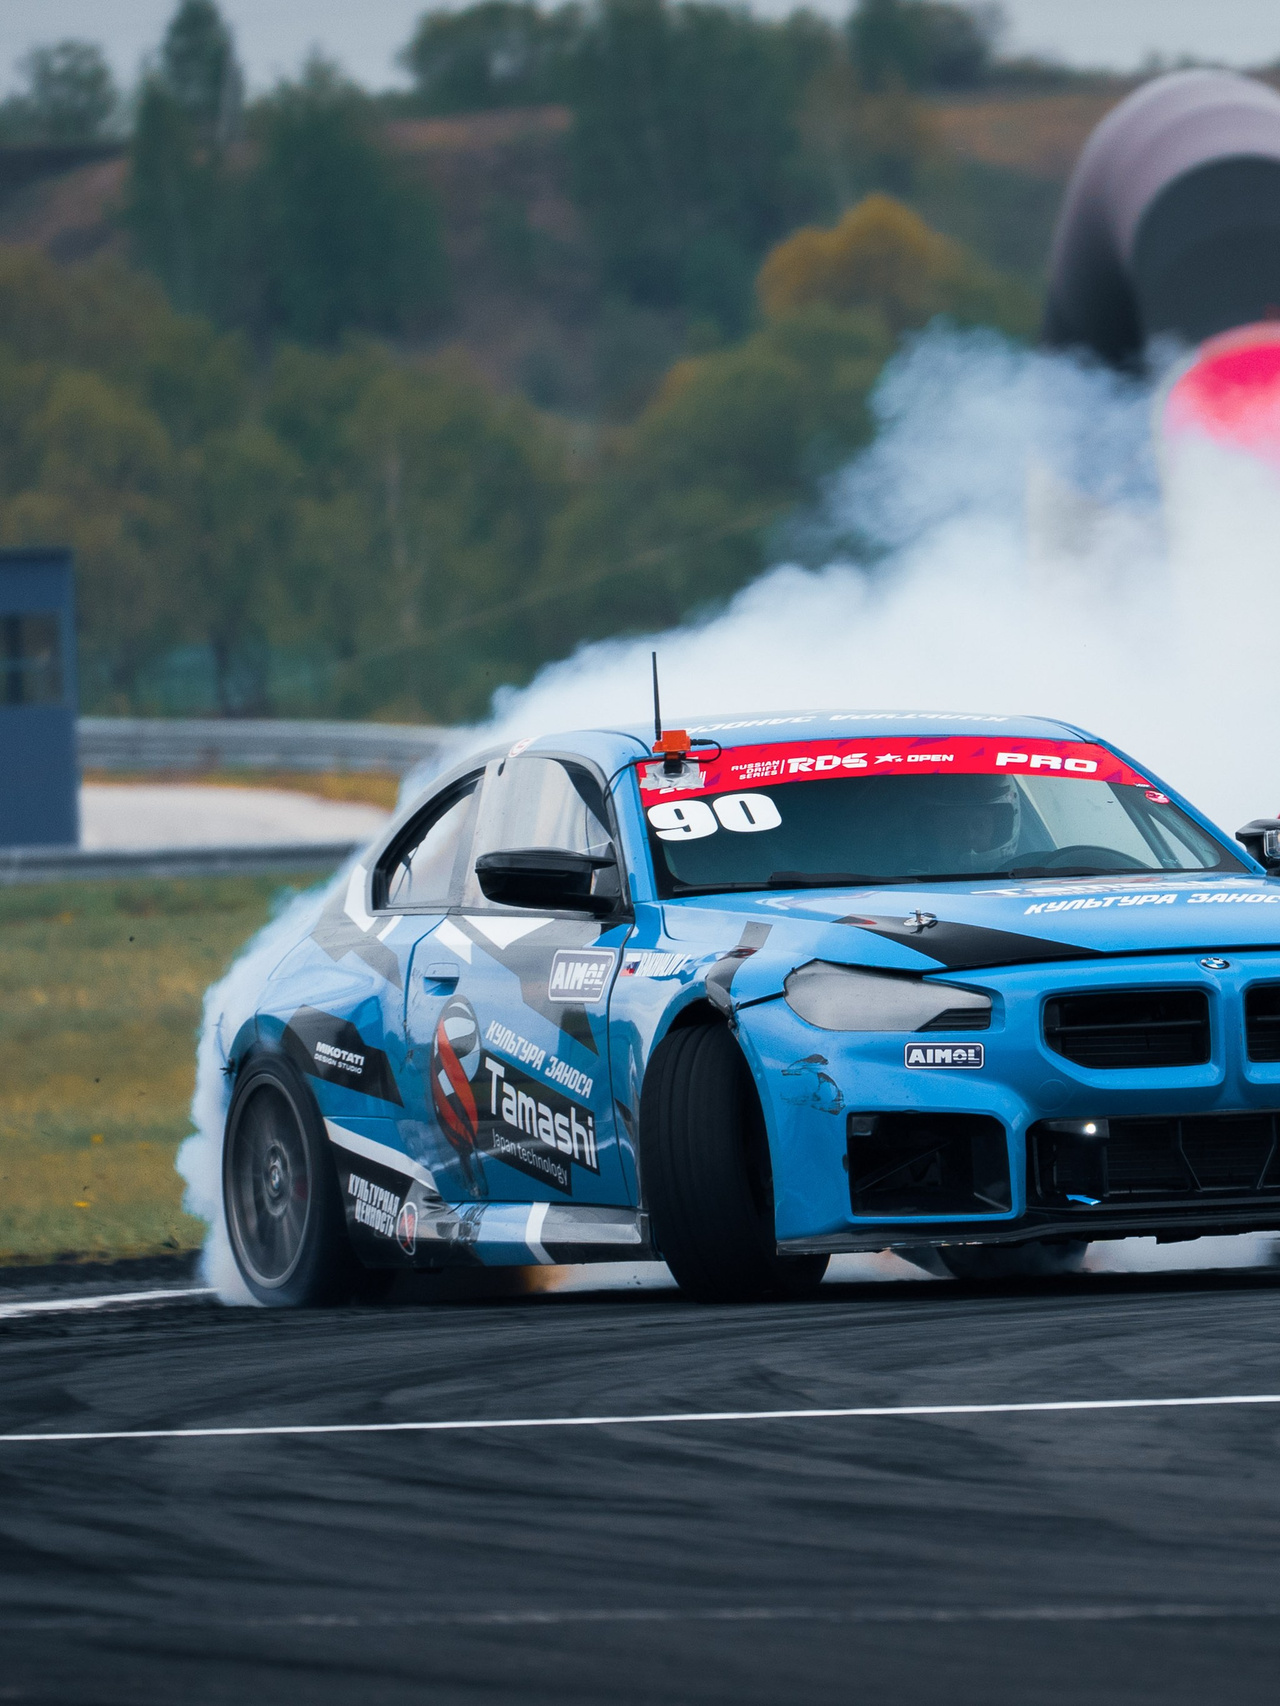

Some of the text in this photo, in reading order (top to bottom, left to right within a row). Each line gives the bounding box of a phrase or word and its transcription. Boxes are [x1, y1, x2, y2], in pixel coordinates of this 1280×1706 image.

[731, 760, 780, 771] RUSSIAN
[746, 766, 778, 774] DRIFT
[787, 753, 954, 774] RDS OPEN
[995, 752, 1098, 773] PRO
[739, 770, 778, 780] SERIES
[647, 793, 783, 841] 90
[1023, 894, 1178, 915] КУЛЬТУРА
[551, 961, 604, 990] AIMOL
[316, 1041, 365, 1066] MIKOTATI
[485, 1020, 593, 1098] КУЛЬТУРА ЗАНОСА
[908, 1048, 980, 1064] AIMOL
[338, 1061, 362, 1074] STUDIO
[485, 1056, 598, 1169] Tamashi
[492, 1128, 568, 1187] Japan technology
[348, 1173, 400, 1217] КУЛЬТУРНАЯ
[355, 1199, 394, 1238] ЦЕННОСТЬ
